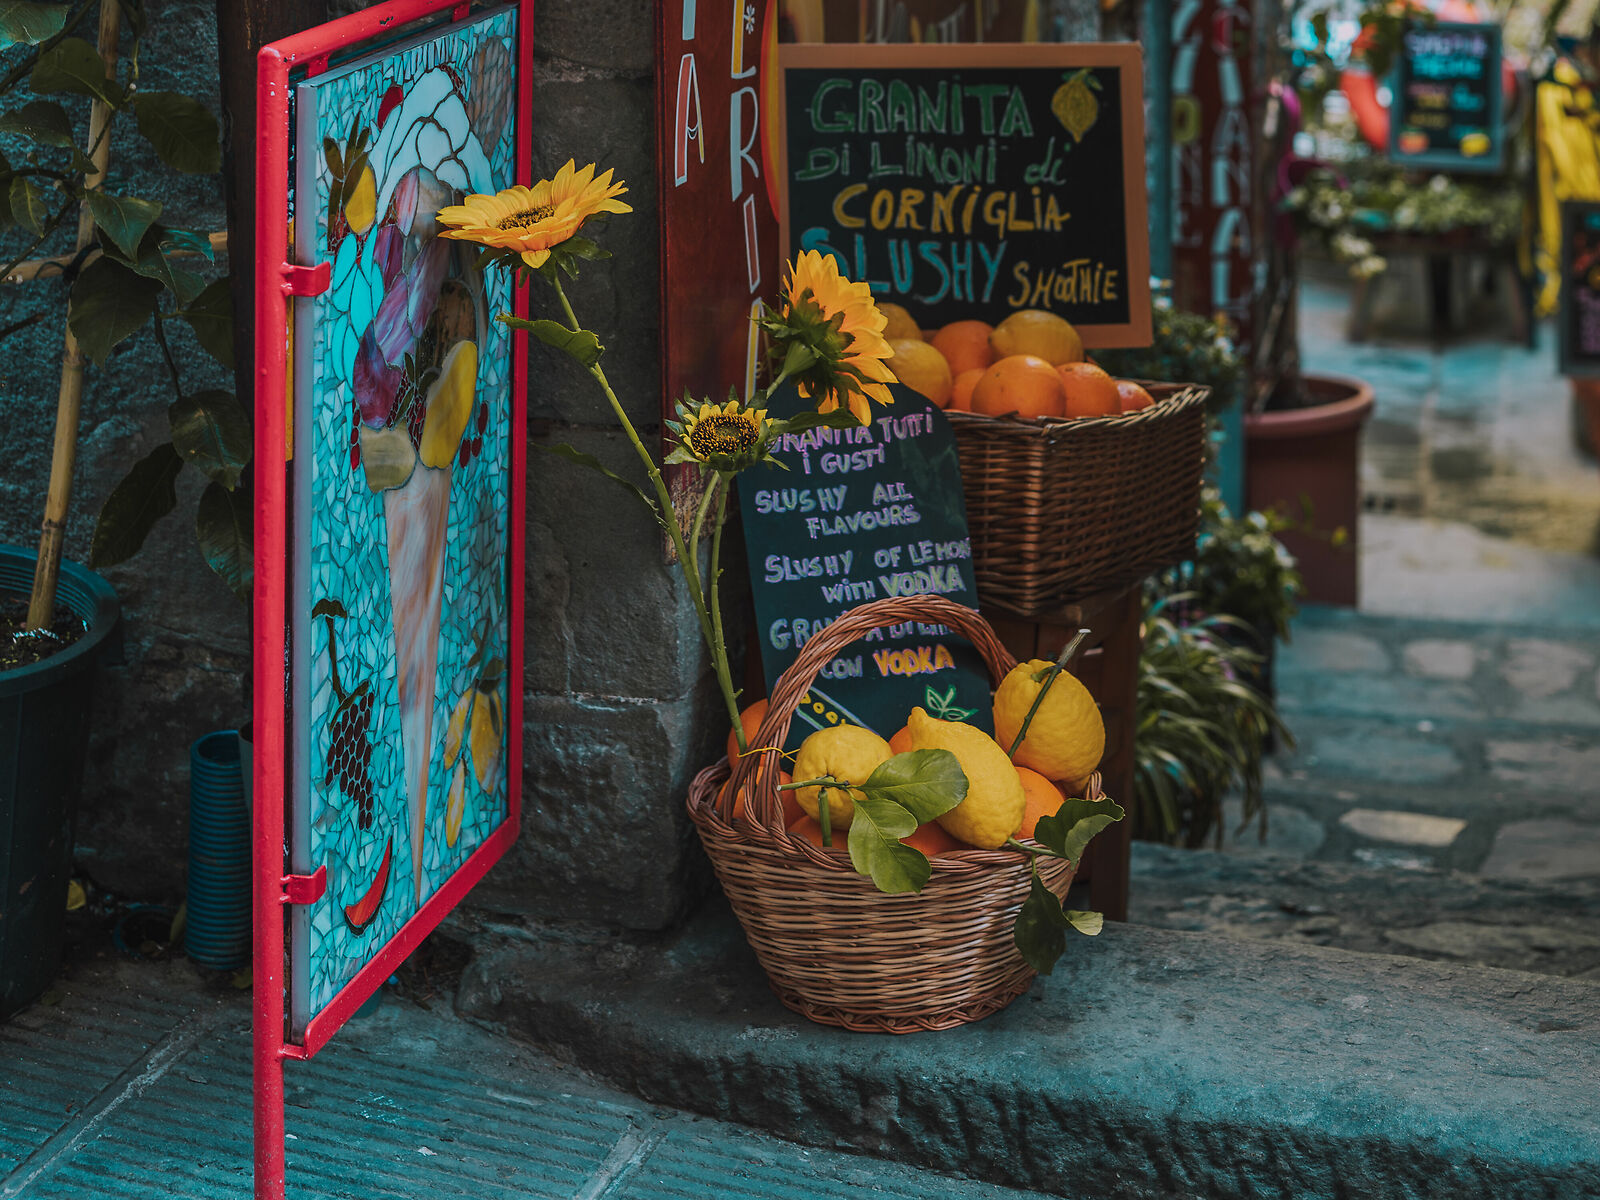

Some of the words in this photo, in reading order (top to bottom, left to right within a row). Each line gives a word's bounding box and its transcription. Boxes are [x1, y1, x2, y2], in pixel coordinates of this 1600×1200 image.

[805, 75, 1034, 137] GRANITA
[801, 226, 1007, 304] SLUSHY
[876, 406, 934, 444] TUTTI
[820, 443, 885, 474] GUSTI
[755, 484, 848, 514] SLUSHY
[872, 482, 914, 506] ALL
[805, 503, 921, 540] FLAVOURS
[765, 550, 853, 583] SLUSHY
[874, 546, 901, 569] OF
[908, 537, 971, 566] LEMON
[821, 578, 876, 604] WITH
[878, 563, 967, 598] VODKA
[820, 655, 864, 680] CON
[872, 643, 956, 677] VODKA
